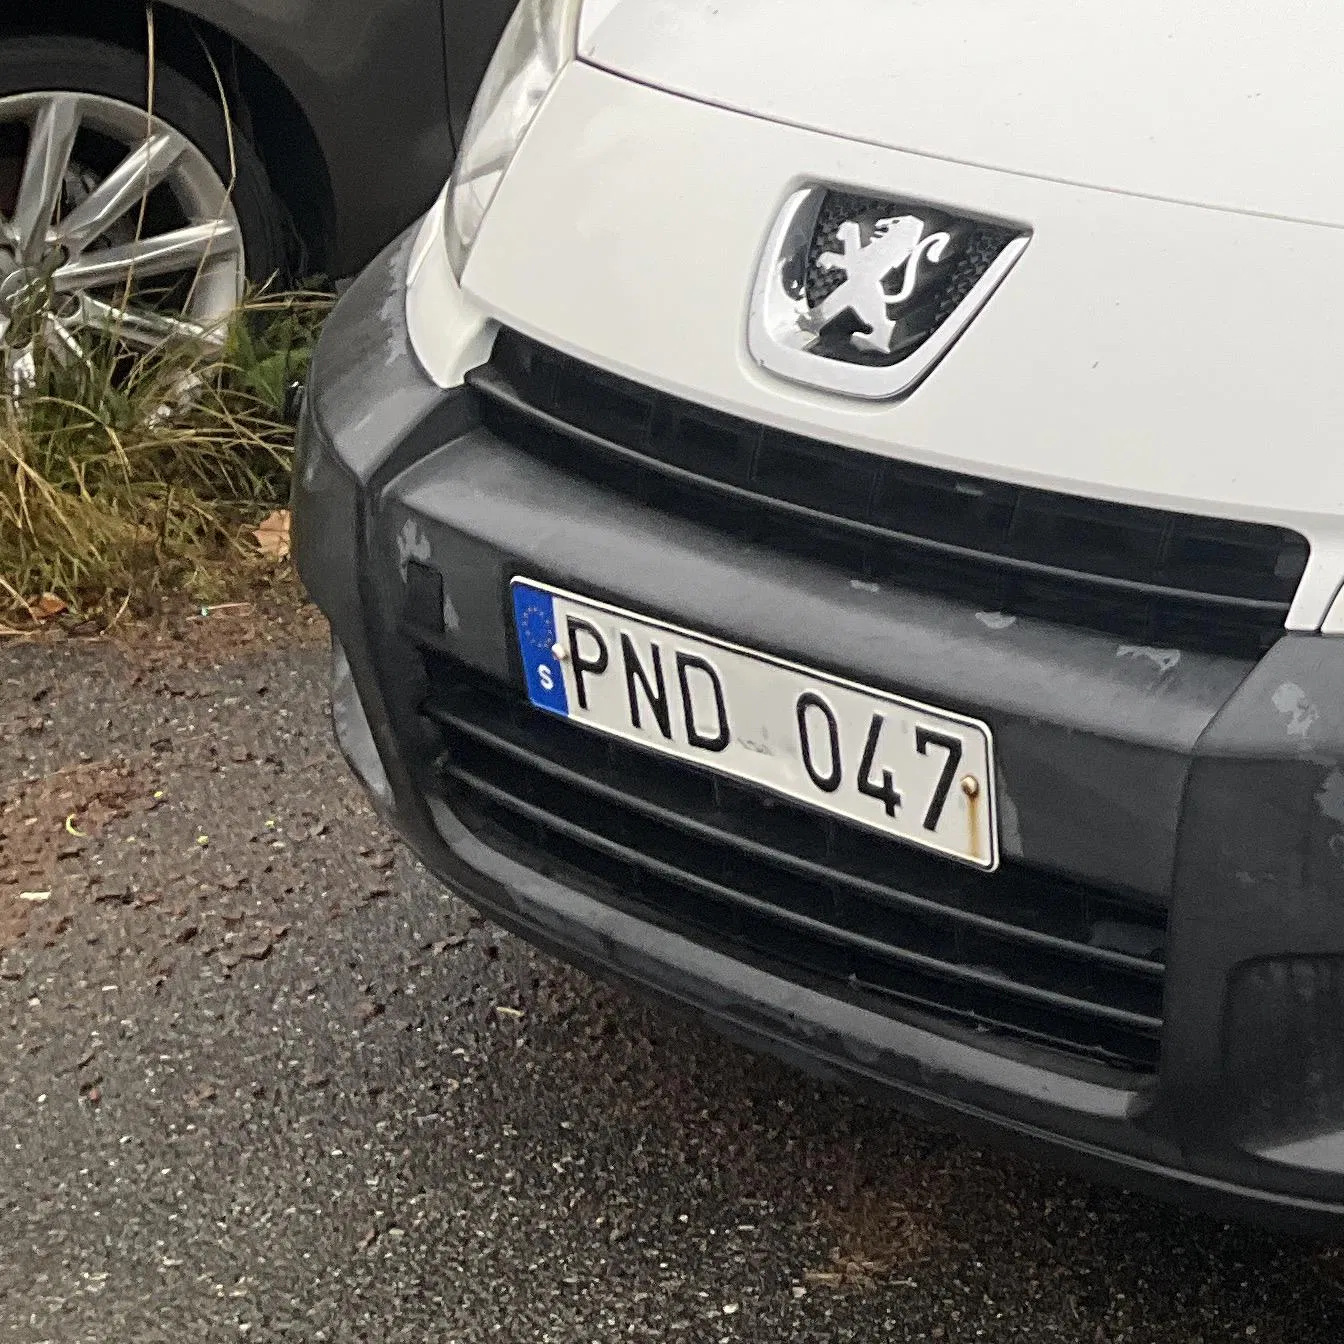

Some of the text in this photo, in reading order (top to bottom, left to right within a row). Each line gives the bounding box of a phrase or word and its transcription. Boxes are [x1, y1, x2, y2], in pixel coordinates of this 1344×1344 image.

[538, 664, 554, 691] S
[566, 614, 964, 832] PND 047
